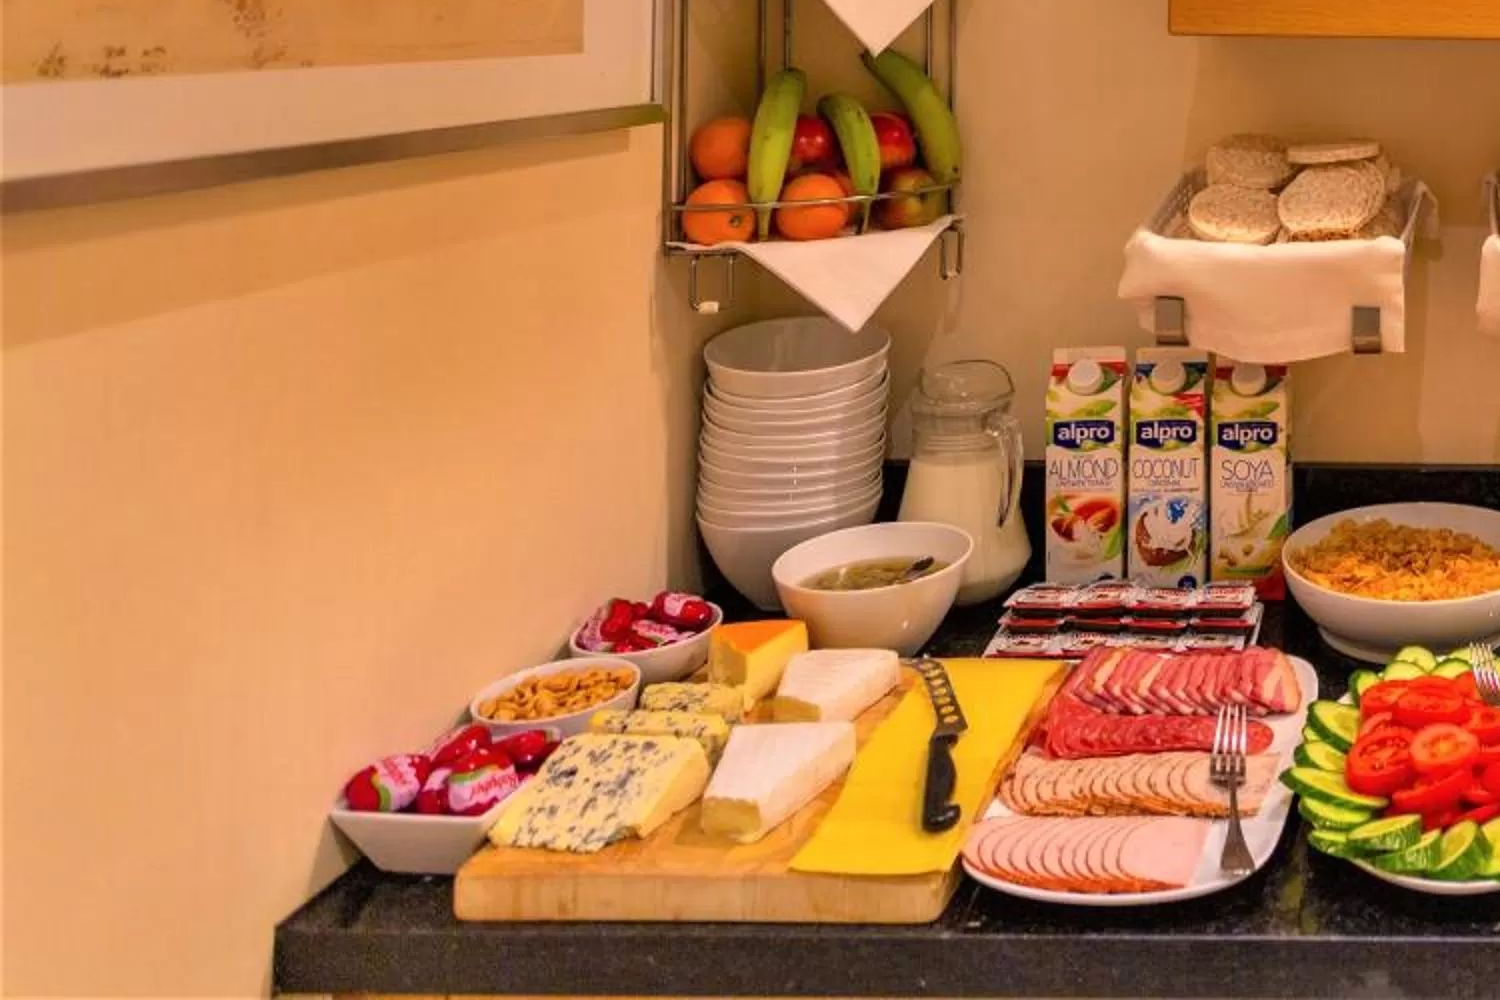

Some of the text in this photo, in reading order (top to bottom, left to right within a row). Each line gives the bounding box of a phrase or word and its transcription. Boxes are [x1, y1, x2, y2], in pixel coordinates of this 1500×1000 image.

[1056, 423, 1111, 445] alpro
[1140, 422, 1193, 444] alpro
[1221, 424, 1274, 445] alpro
[1049, 457, 1119, 480] ALMOND
[1132, 456, 1200, 480] COCONUT
[1220, 458, 1275, 481] SOYA
